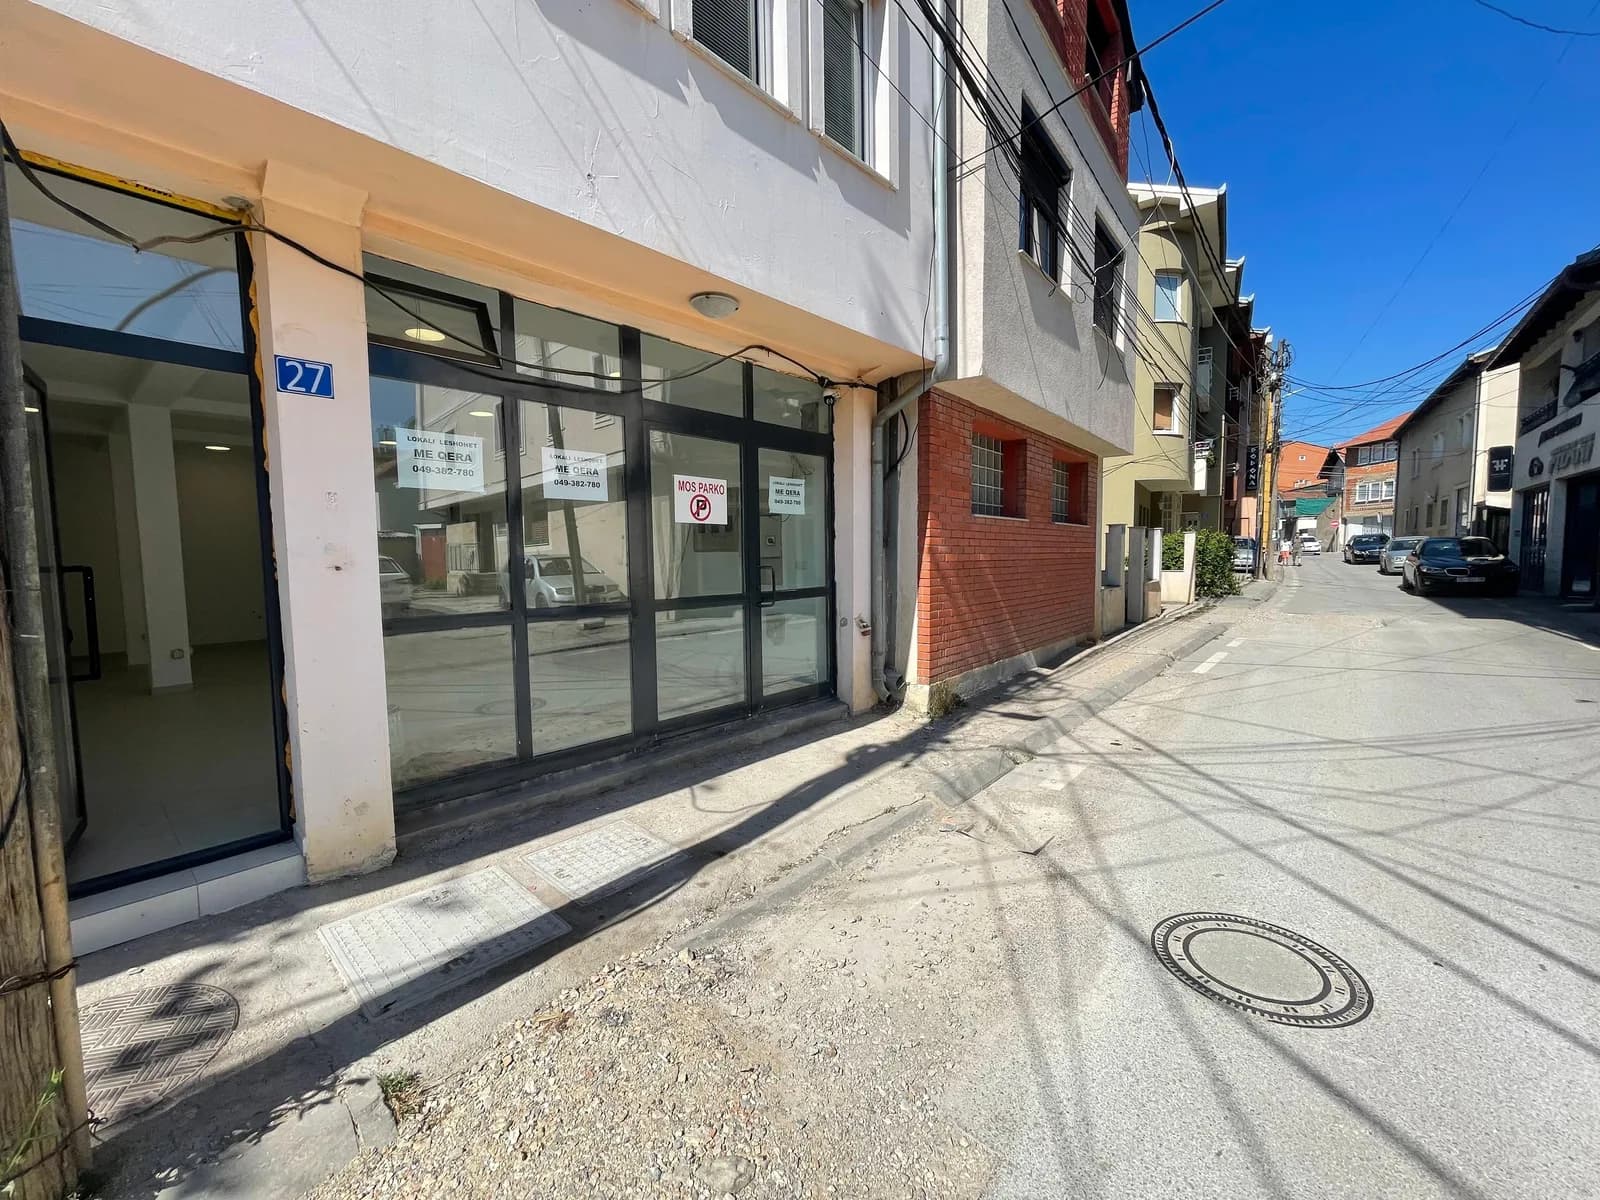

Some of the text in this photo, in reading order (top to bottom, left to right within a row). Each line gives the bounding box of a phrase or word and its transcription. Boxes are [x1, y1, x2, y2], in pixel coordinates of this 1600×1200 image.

[285, 361, 325, 393] 27
[407, 435, 435, 444] LOKALI
[414, 448, 433, 459] ME
[412, 464, 474, 477] 049-382-780
[555, 464, 569, 473] ME
[554, 479, 601, 489] 049-382-780
[678, 480, 725, 495] MOS PARKO
